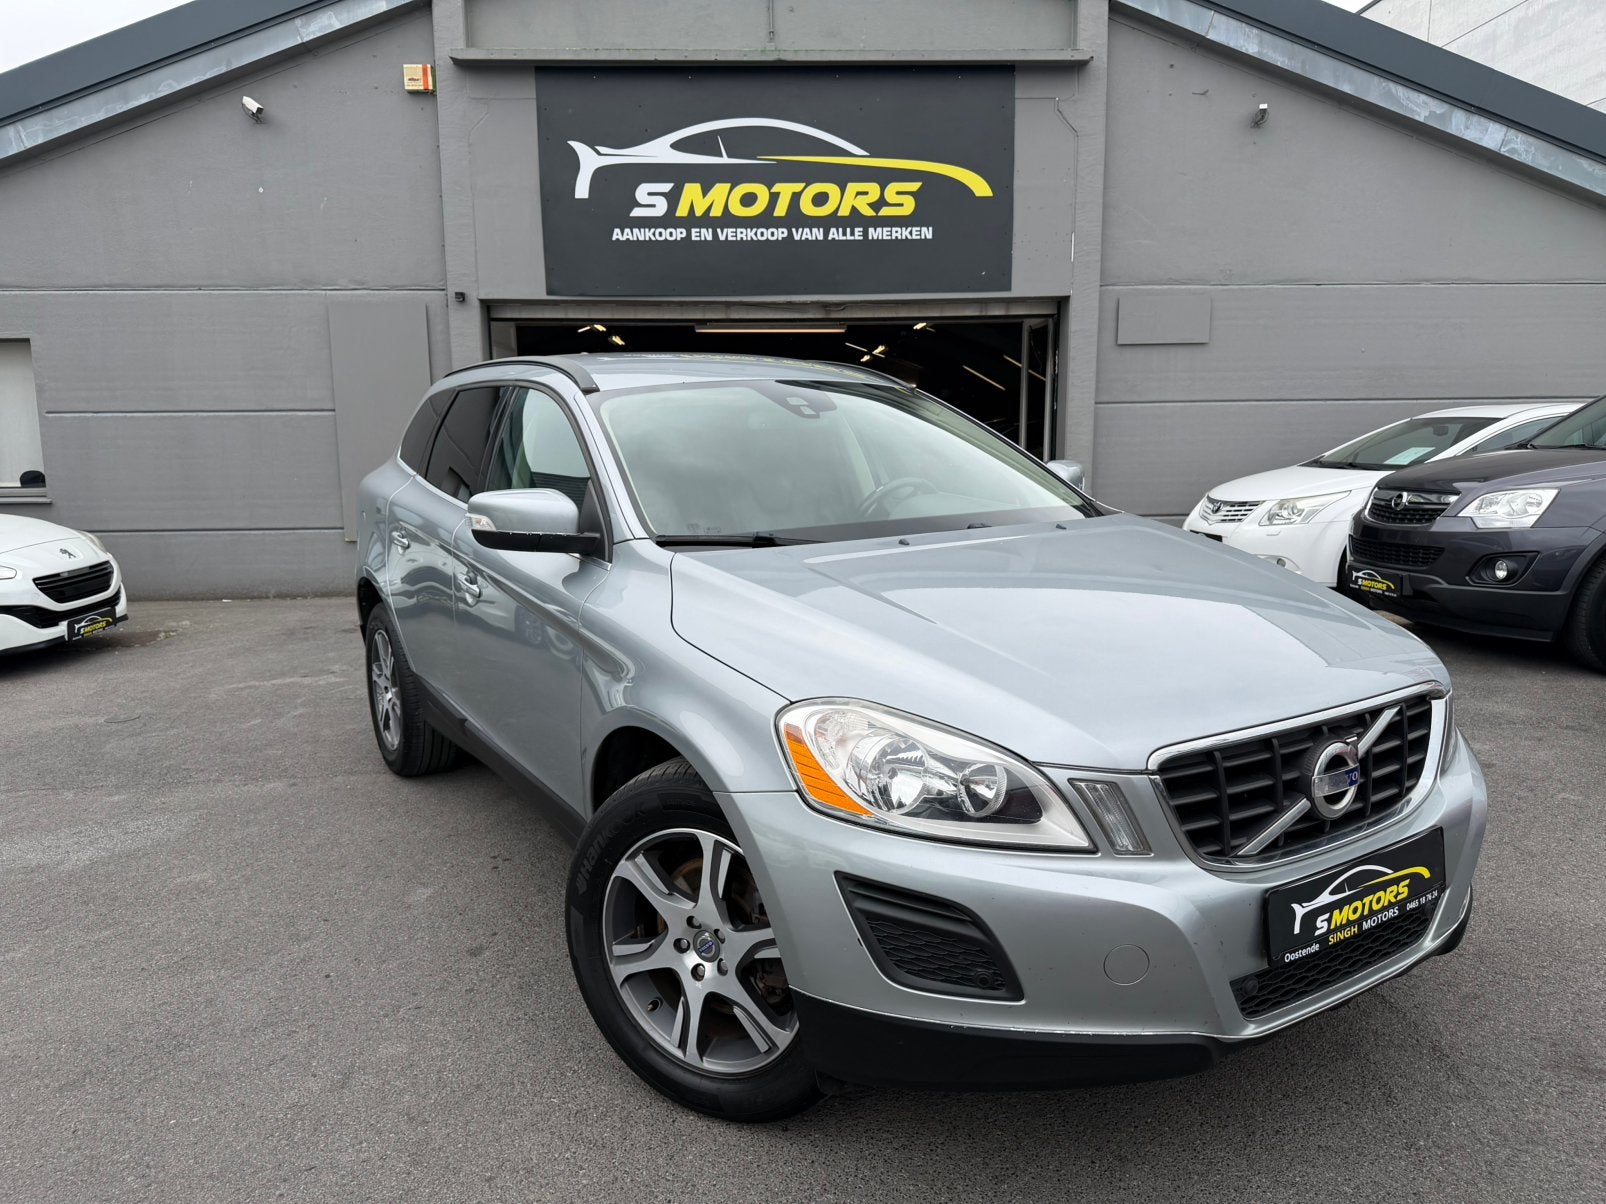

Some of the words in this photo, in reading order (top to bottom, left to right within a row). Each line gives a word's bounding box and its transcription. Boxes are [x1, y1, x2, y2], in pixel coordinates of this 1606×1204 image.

[629, 182, 675, 217] S
[675, 181, 923, 217] MOTORS
[611, 227, 687, 241] AANKOOP
[691, 227, 713, 241] EN
[717, 227, 788, 241] VERKOOP
[791, 227, 824, 241] VAN
[828, 226, 864, 240] ALLE
[868, 226, 933, 240] MERKEN
[1362, 579, 1387, 590] MOTORS
[1314, 912, 1331, 937] S
[1330, 878, 1410, 930] MOTORS
[1284, 943, 1320, 963] Oostende
[1328, 924, 1358, 945] SINGH
[1362, 906, 1399, 931] MOTORS
